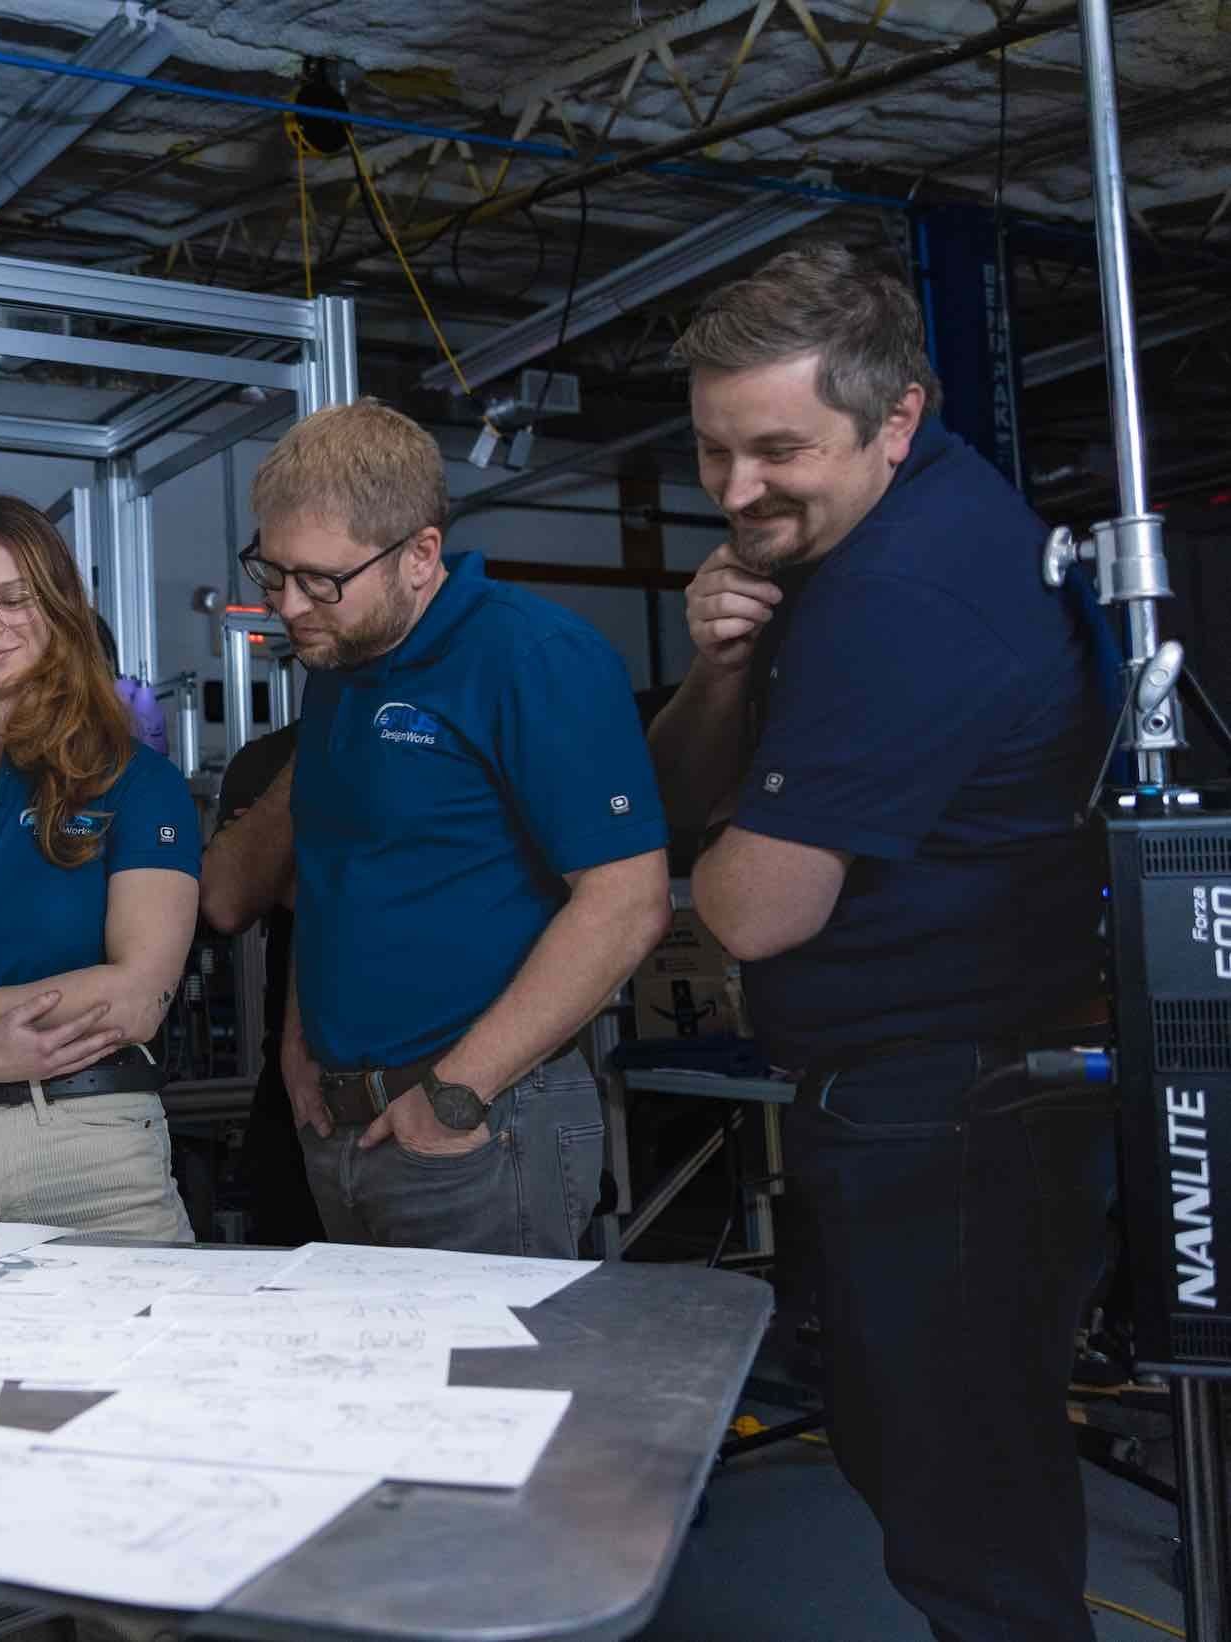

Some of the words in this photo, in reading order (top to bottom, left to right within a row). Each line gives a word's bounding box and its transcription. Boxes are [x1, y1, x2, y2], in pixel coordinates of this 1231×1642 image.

[379, 727, 436, 745] DesignWorks
[1192, 886, 1208, 942] Forza
[1165, 1086, 1217, 1310] NANLITE
